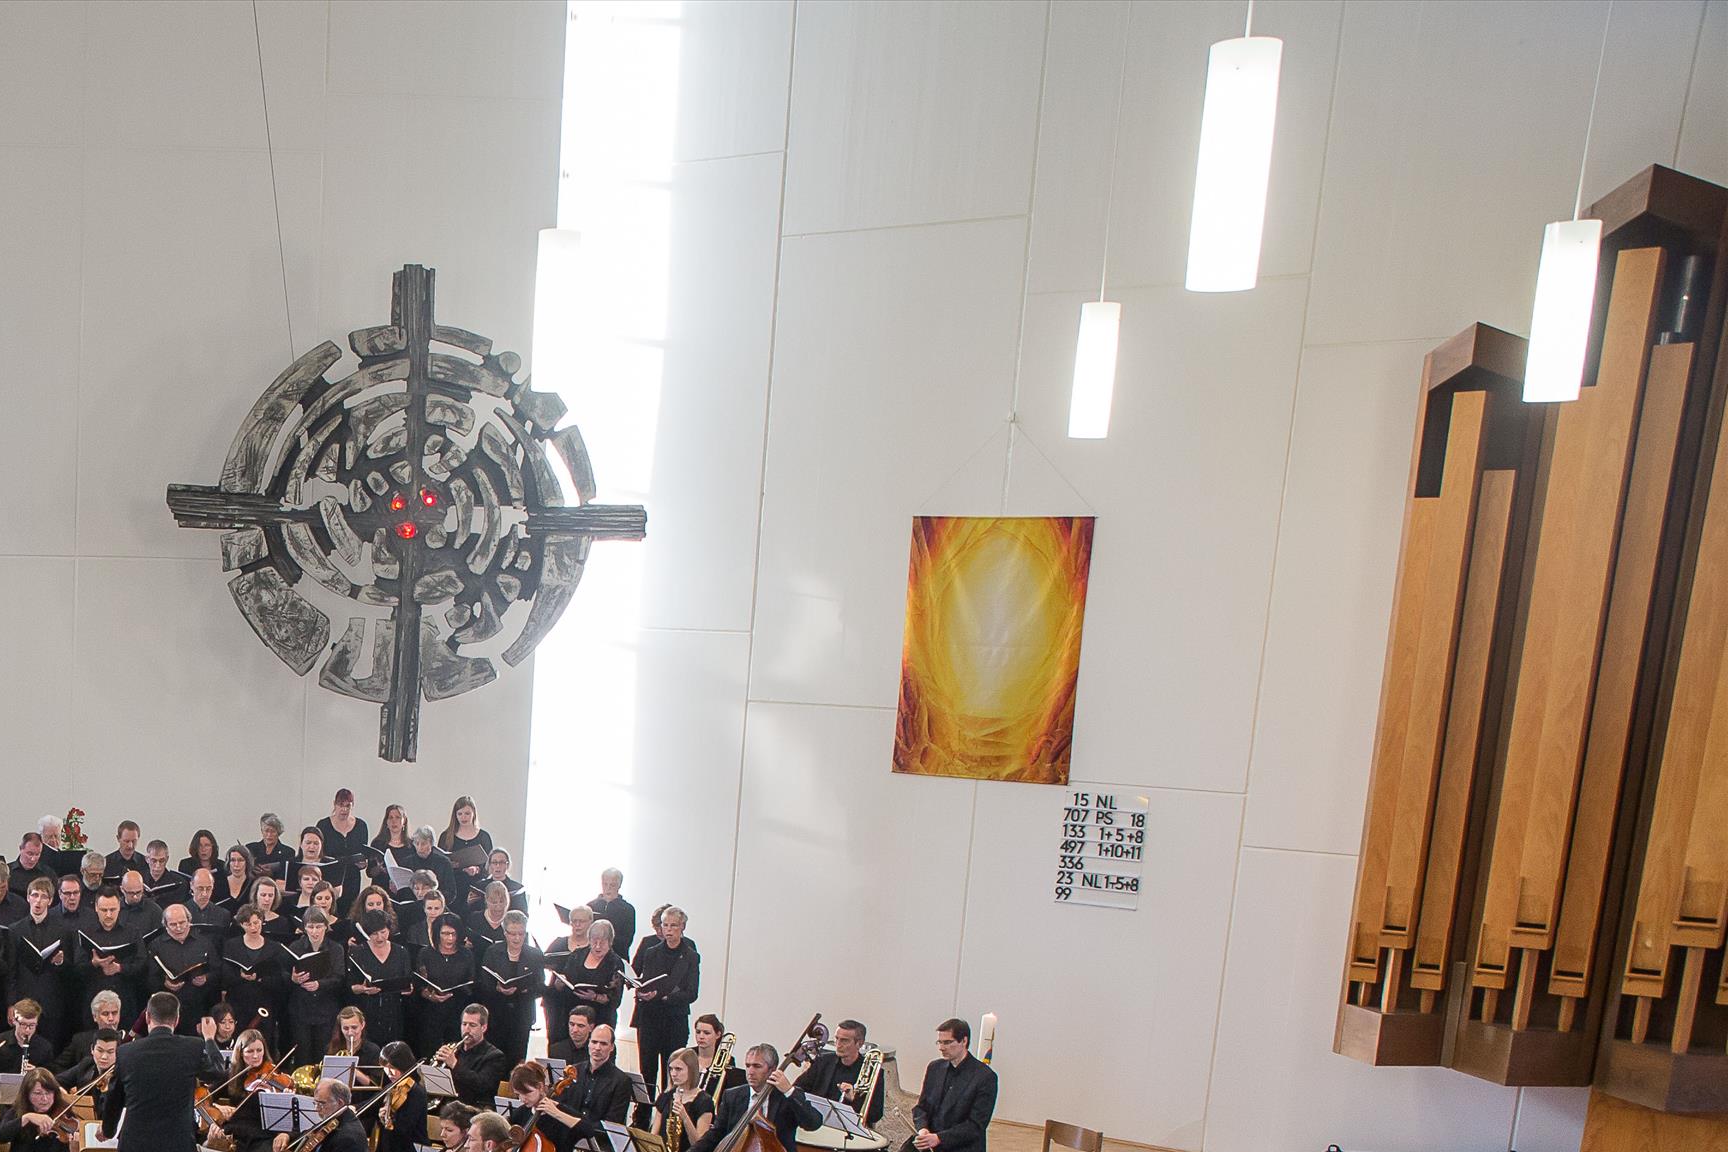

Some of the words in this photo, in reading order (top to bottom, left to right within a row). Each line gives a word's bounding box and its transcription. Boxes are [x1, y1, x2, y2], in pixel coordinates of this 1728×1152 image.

[1074, 793, 1089, 806] 15
[1096, 795, 1117, 810] NL
[1064, 808, 1089, 822] 707
[1096, 811, 1113, 825] PS
[1131, 814, 1145, 828] 18
[1063, 824, 1085, 838] 133
[1060, 840, 1085, 854] 497
[1059, 856, 1084, 870] 336
[1056, 871, 1073, 885] 23
[1055, 887, 1072, 900] 99
